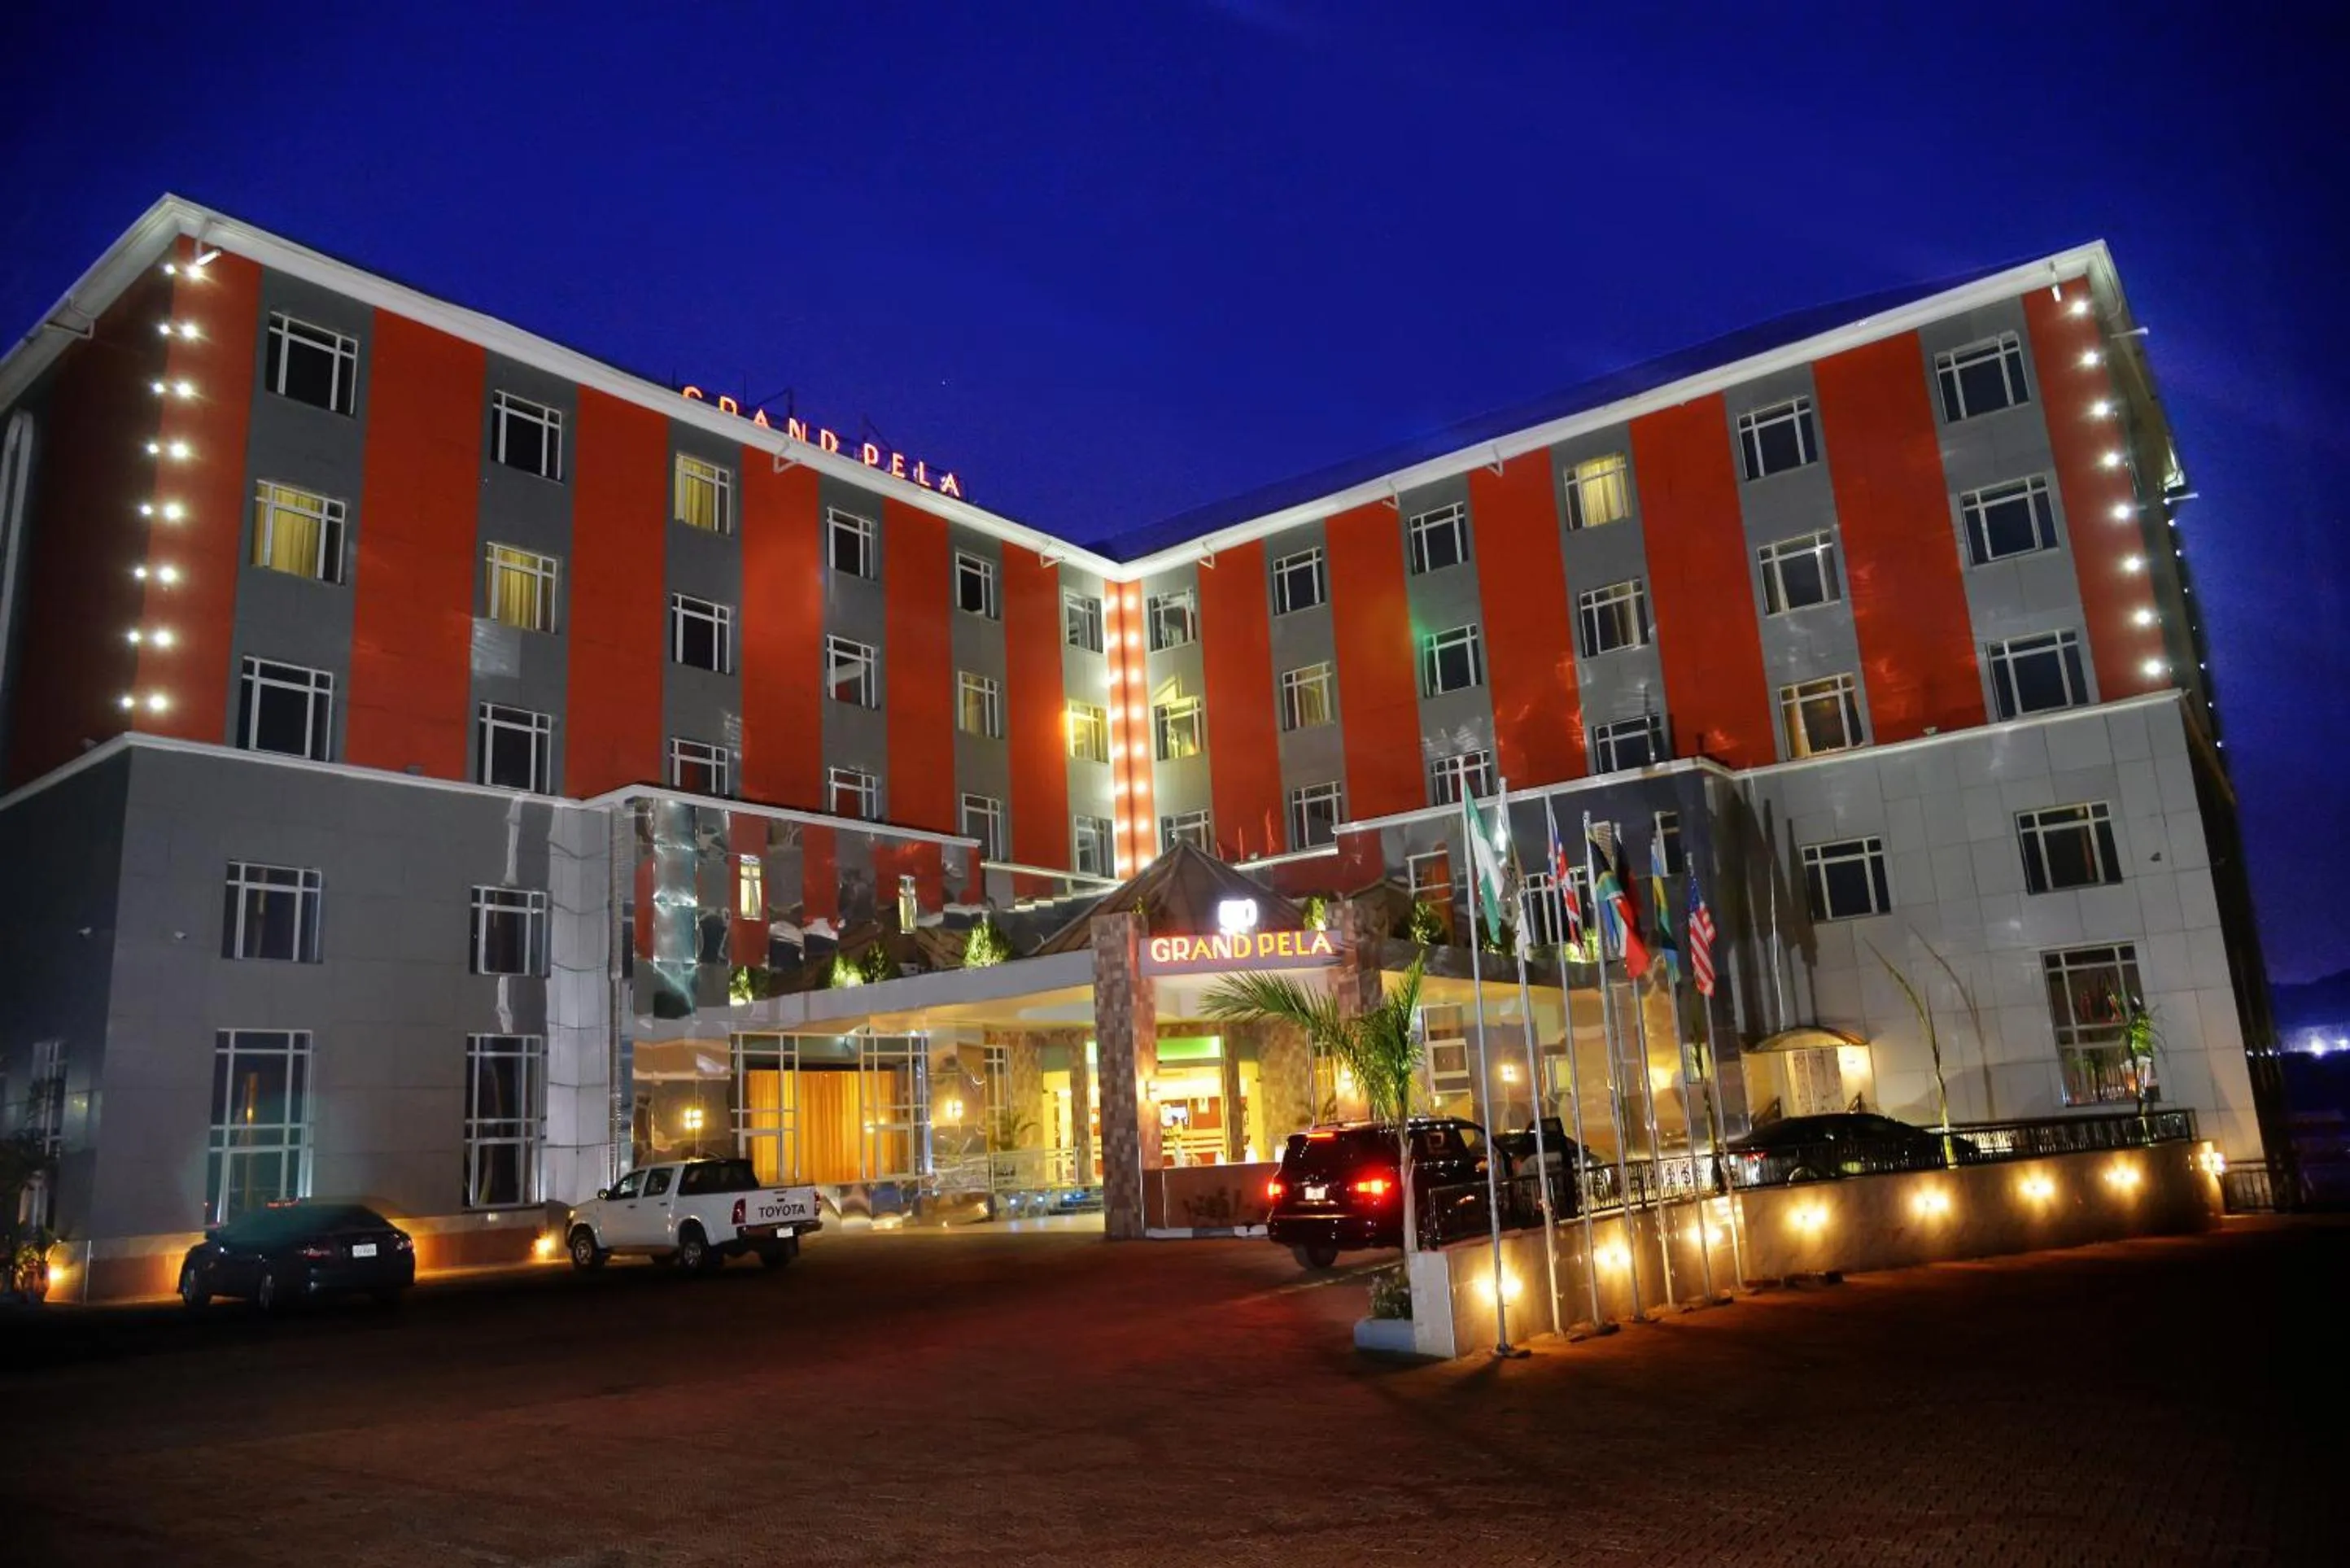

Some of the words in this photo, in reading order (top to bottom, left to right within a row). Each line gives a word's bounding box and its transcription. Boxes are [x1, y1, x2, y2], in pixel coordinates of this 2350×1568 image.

[863, 443, 960, 497] PELA
[1151, 936, 1251, 963] GRAND
[1257, 931, 1333, 958] PELA
[758, 1204, 806, 1218] TOYOTA
